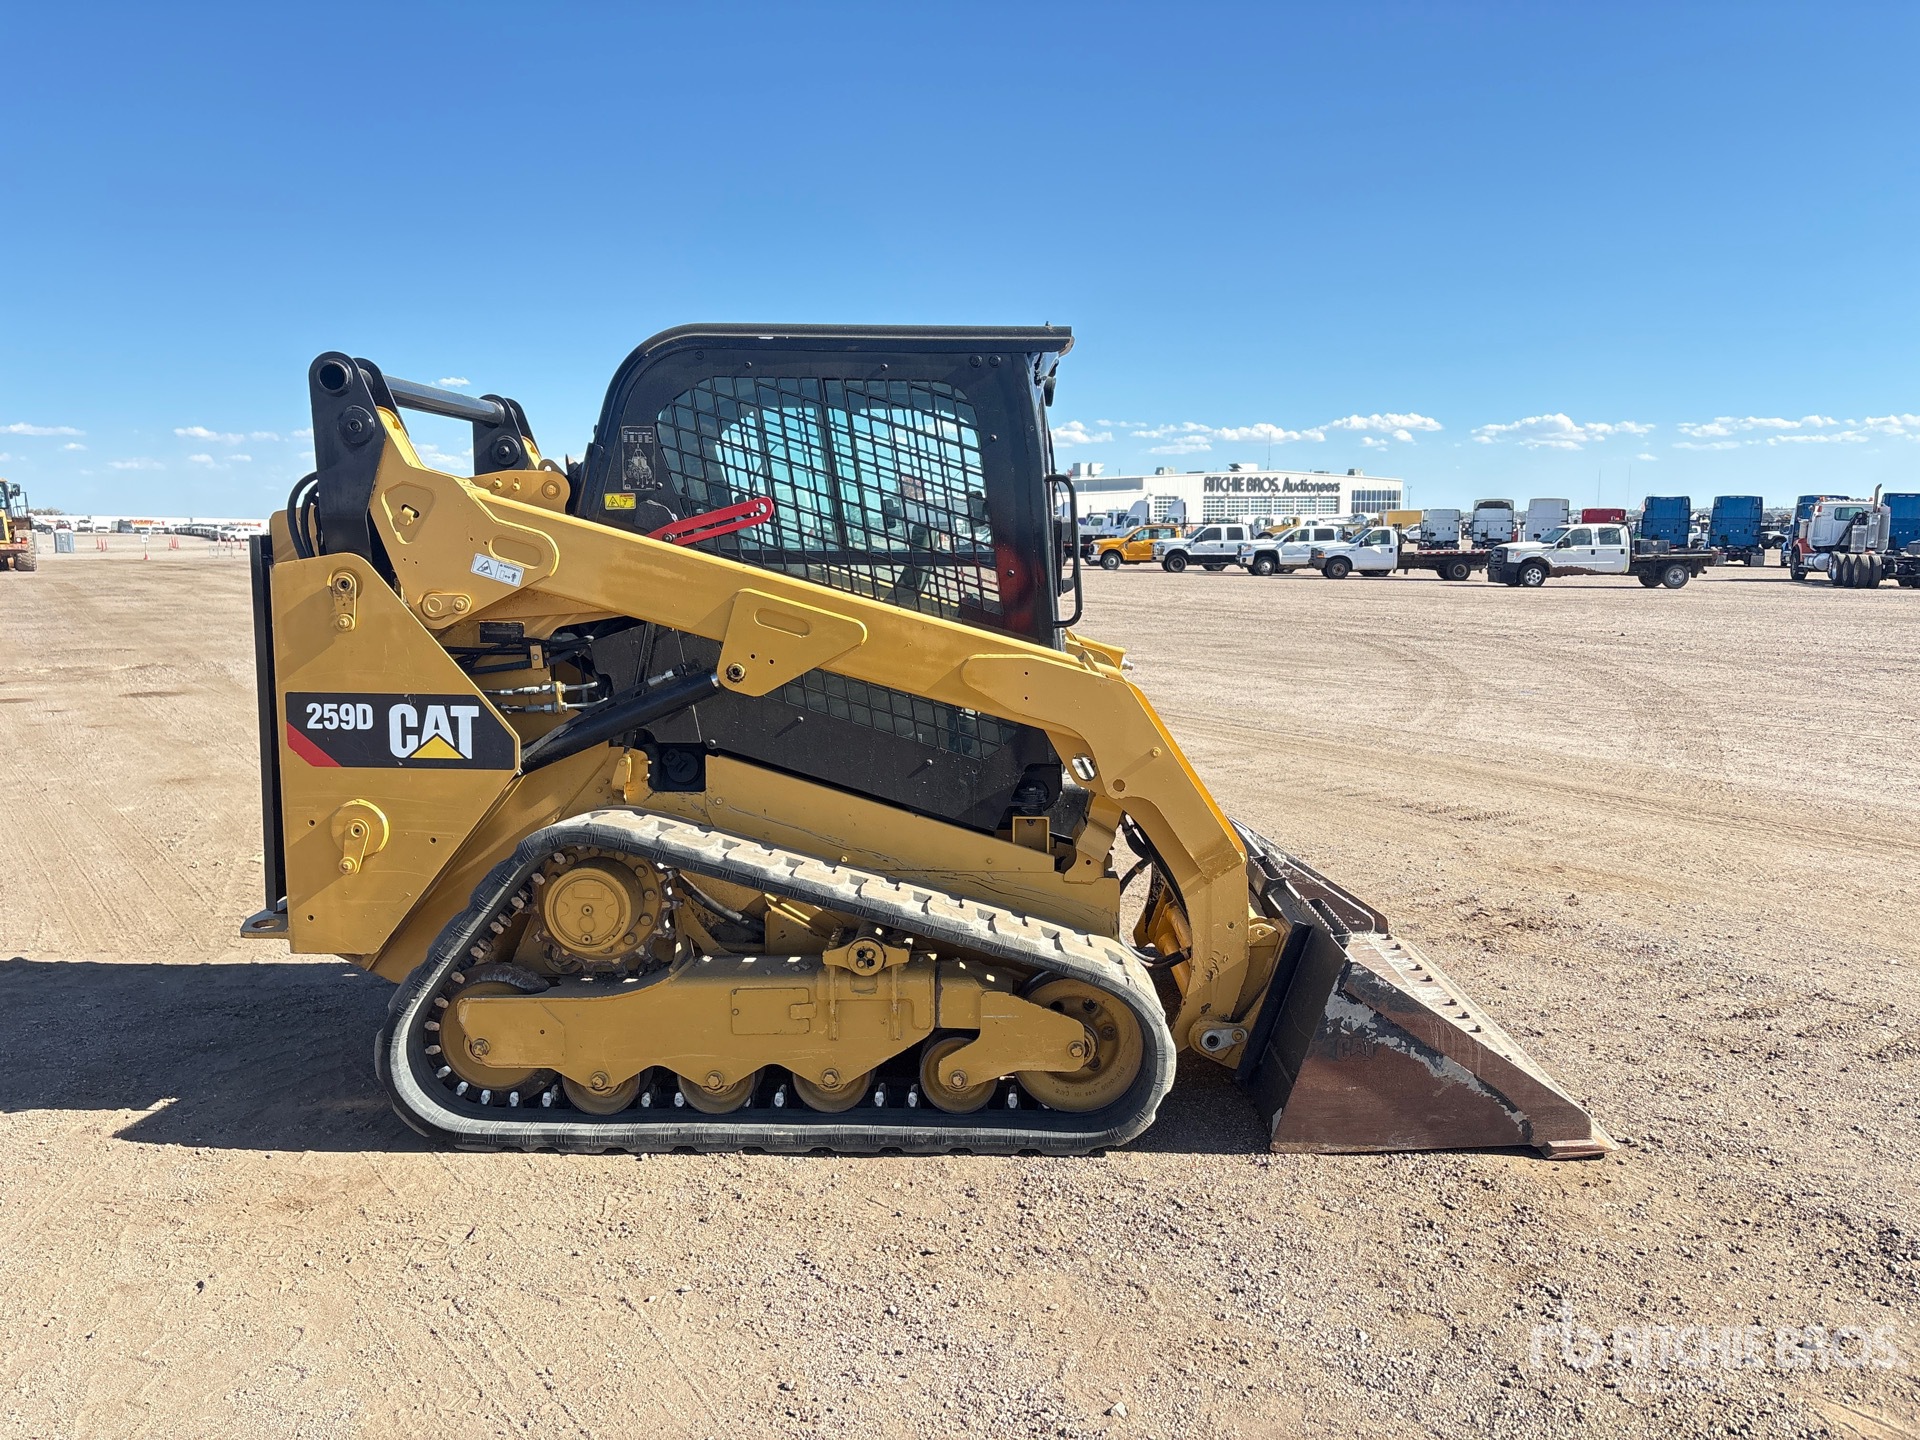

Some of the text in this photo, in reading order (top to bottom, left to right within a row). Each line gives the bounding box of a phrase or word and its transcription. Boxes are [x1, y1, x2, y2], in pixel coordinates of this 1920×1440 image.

[1203, 477, 1340, 493] RITCHIE BROS. Auctioneers
[306, 702, 480, 760] 259D CAT
